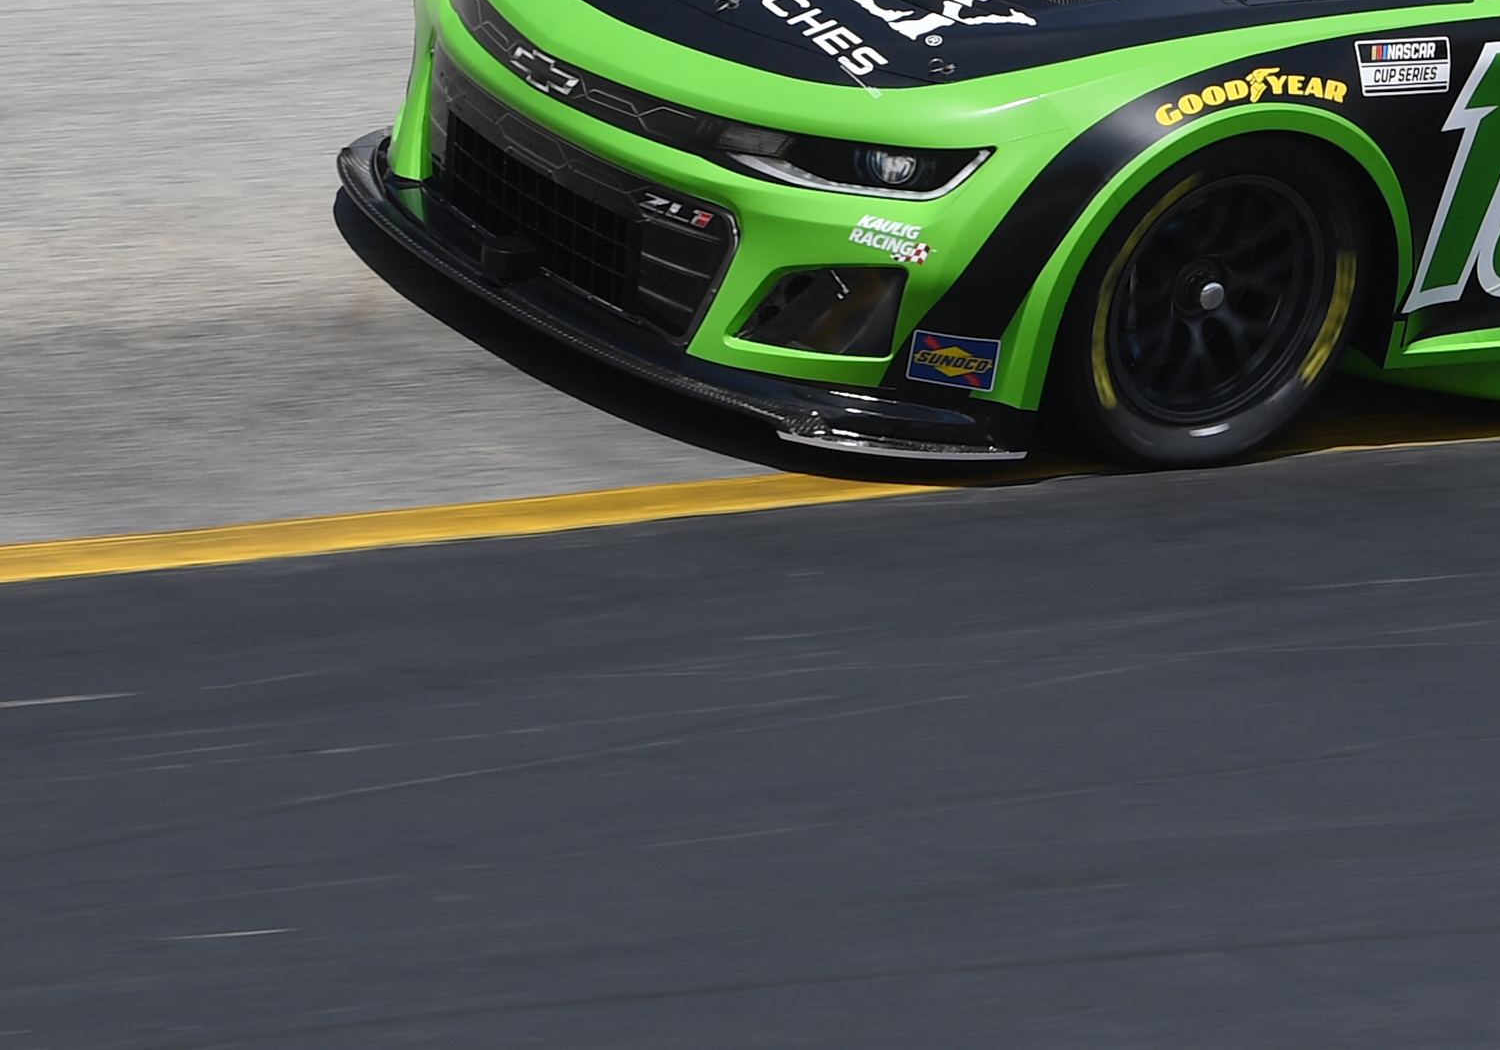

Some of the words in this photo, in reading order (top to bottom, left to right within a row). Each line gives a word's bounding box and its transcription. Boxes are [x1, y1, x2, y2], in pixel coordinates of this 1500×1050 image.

[1386, 42, 1436, 60] NASCAR
[1373, 67, 1397, 83] CUP
[1397, 66, 1438, 82] SERIES
[857, 214, 922, 240] KAULIG
[849, 228, 916, 257] RACING
[917, 351, 990, 371] SUNOCO
